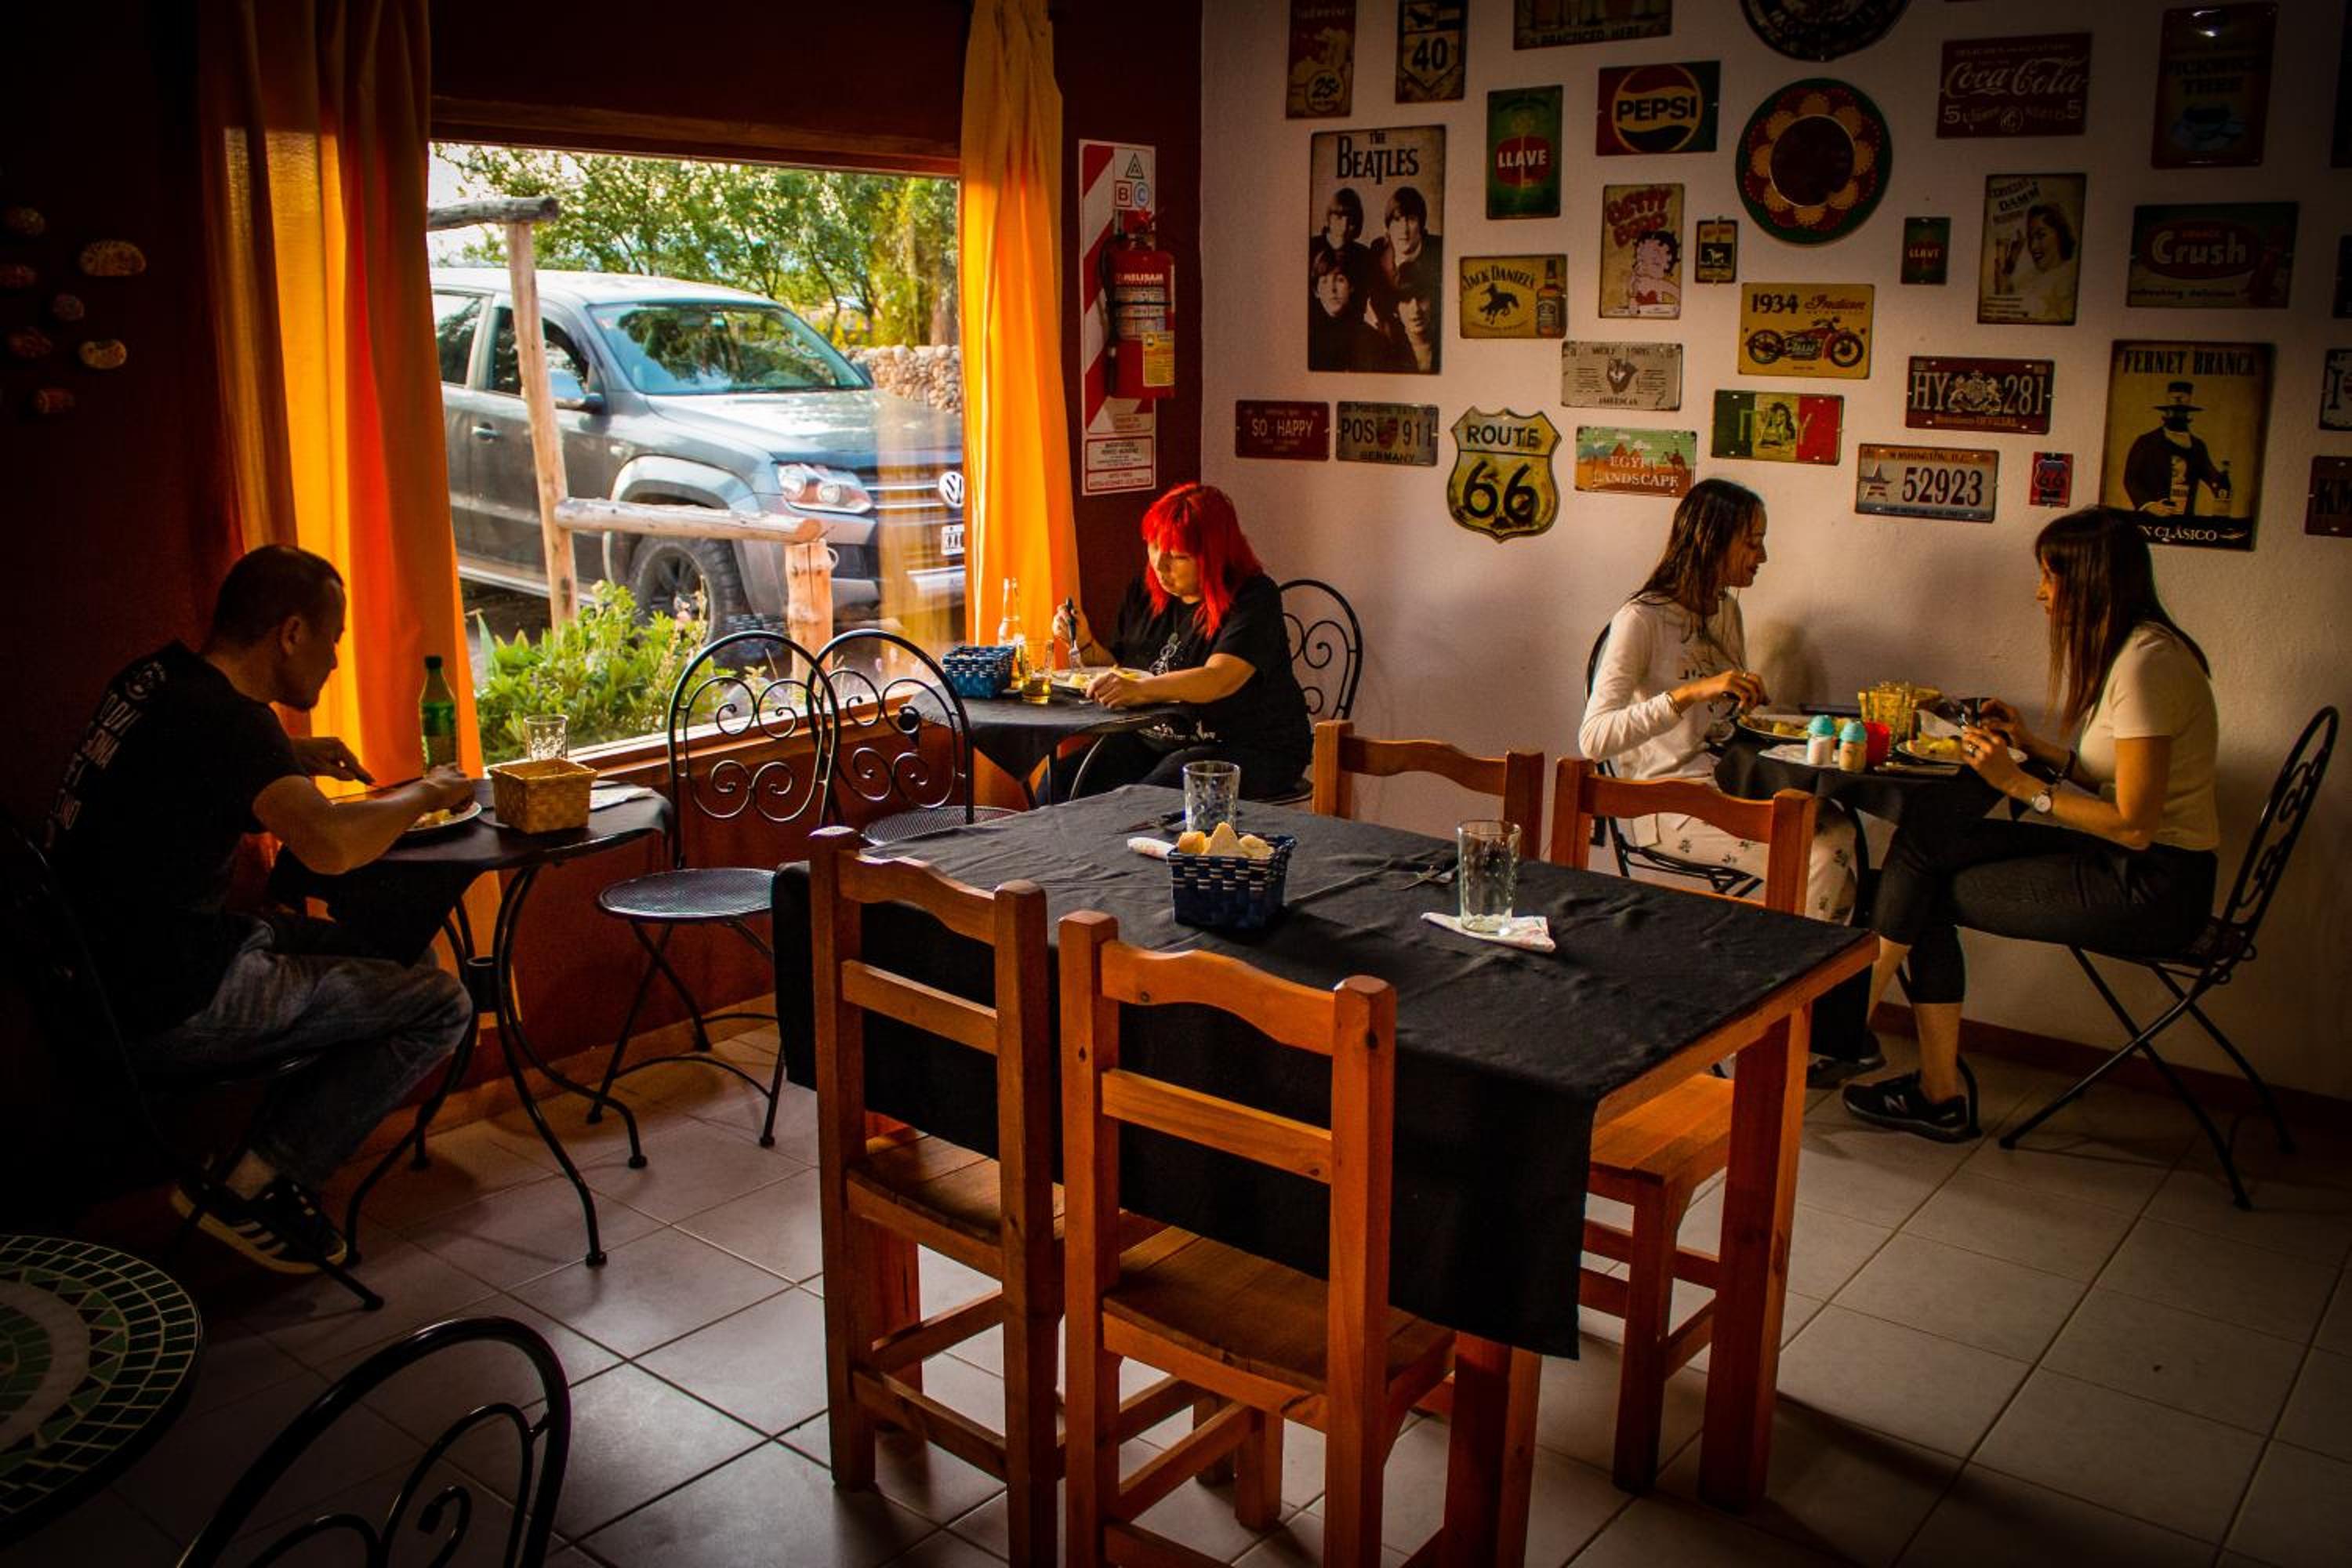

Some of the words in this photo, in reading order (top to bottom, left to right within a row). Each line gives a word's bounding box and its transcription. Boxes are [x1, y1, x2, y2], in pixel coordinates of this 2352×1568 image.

[1411, 37, 1448, 72] 40
[1616, 96, 1697, 122] PEPSI
[1337, 135, 1419, 184] BEATLES
[1497, 149, 1548, 169] LLAVE
[1119, 187, 1128, 201] B
[1606, 188, 1672, 225] BETTY
[2151, 230, 2247, 264] Crush
[1751, 292, 1799, 314] 1934
[2122, 350, 2187, 376] FERNET
[2193, 350, 2256, 376] BRANCA
[1911, 372, 1951, 412] HY
[2003, 374, 2045, 416] 281
[1250, 417, 1269, 437] SO
[1276, 419, 1314, 439] HAPPY
[1403, 420, 1432, 448] 911
[1466, 424, 1540, 448] ROUTE
[1359, 450, 1415, 464] GERMANY
[1463, 460, 1541, 525] 66
[1901, 466, 1983, 506] 52923
